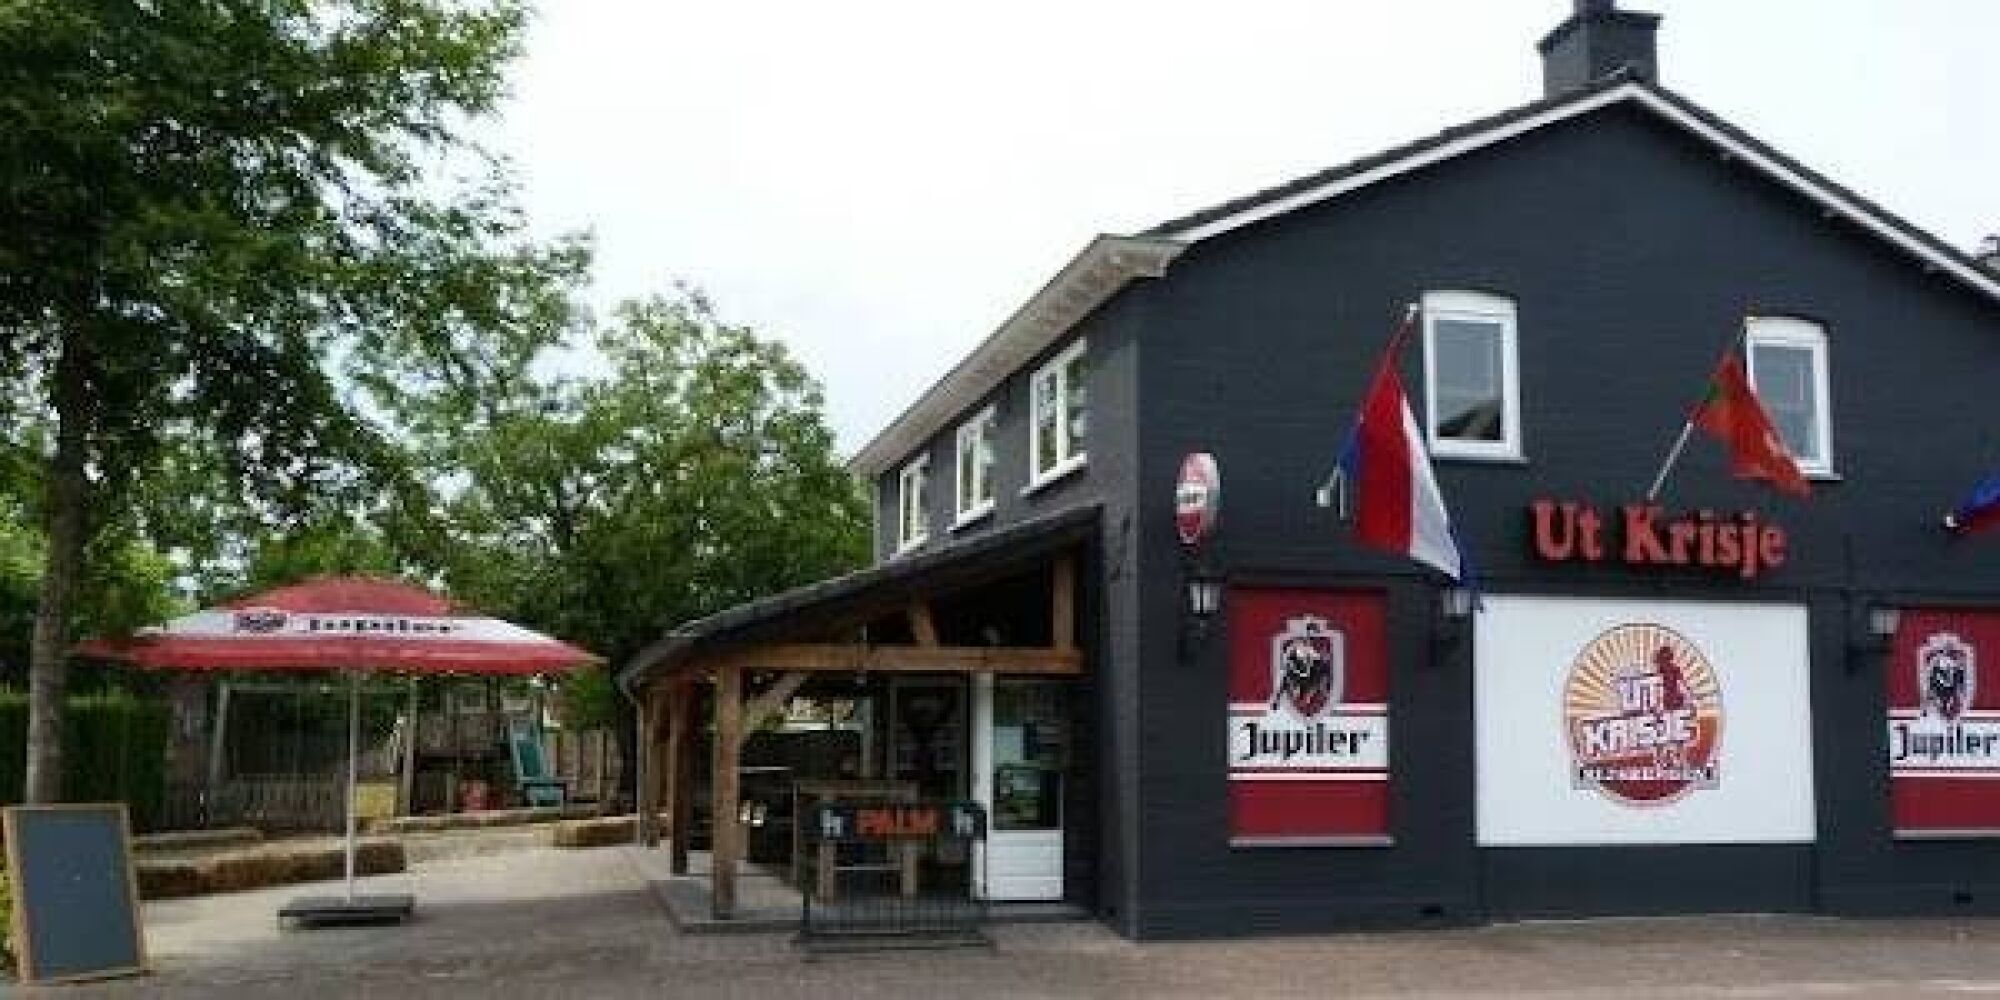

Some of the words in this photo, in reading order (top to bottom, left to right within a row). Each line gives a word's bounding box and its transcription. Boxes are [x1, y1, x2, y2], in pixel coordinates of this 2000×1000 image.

[1530, 501, 1602, 562] Ut
[1624, 503, 1787, 578] Krisje
[1240, 722, 1371, 761] Jupiler
[1892, 724, 1998, 761] Jupiler
